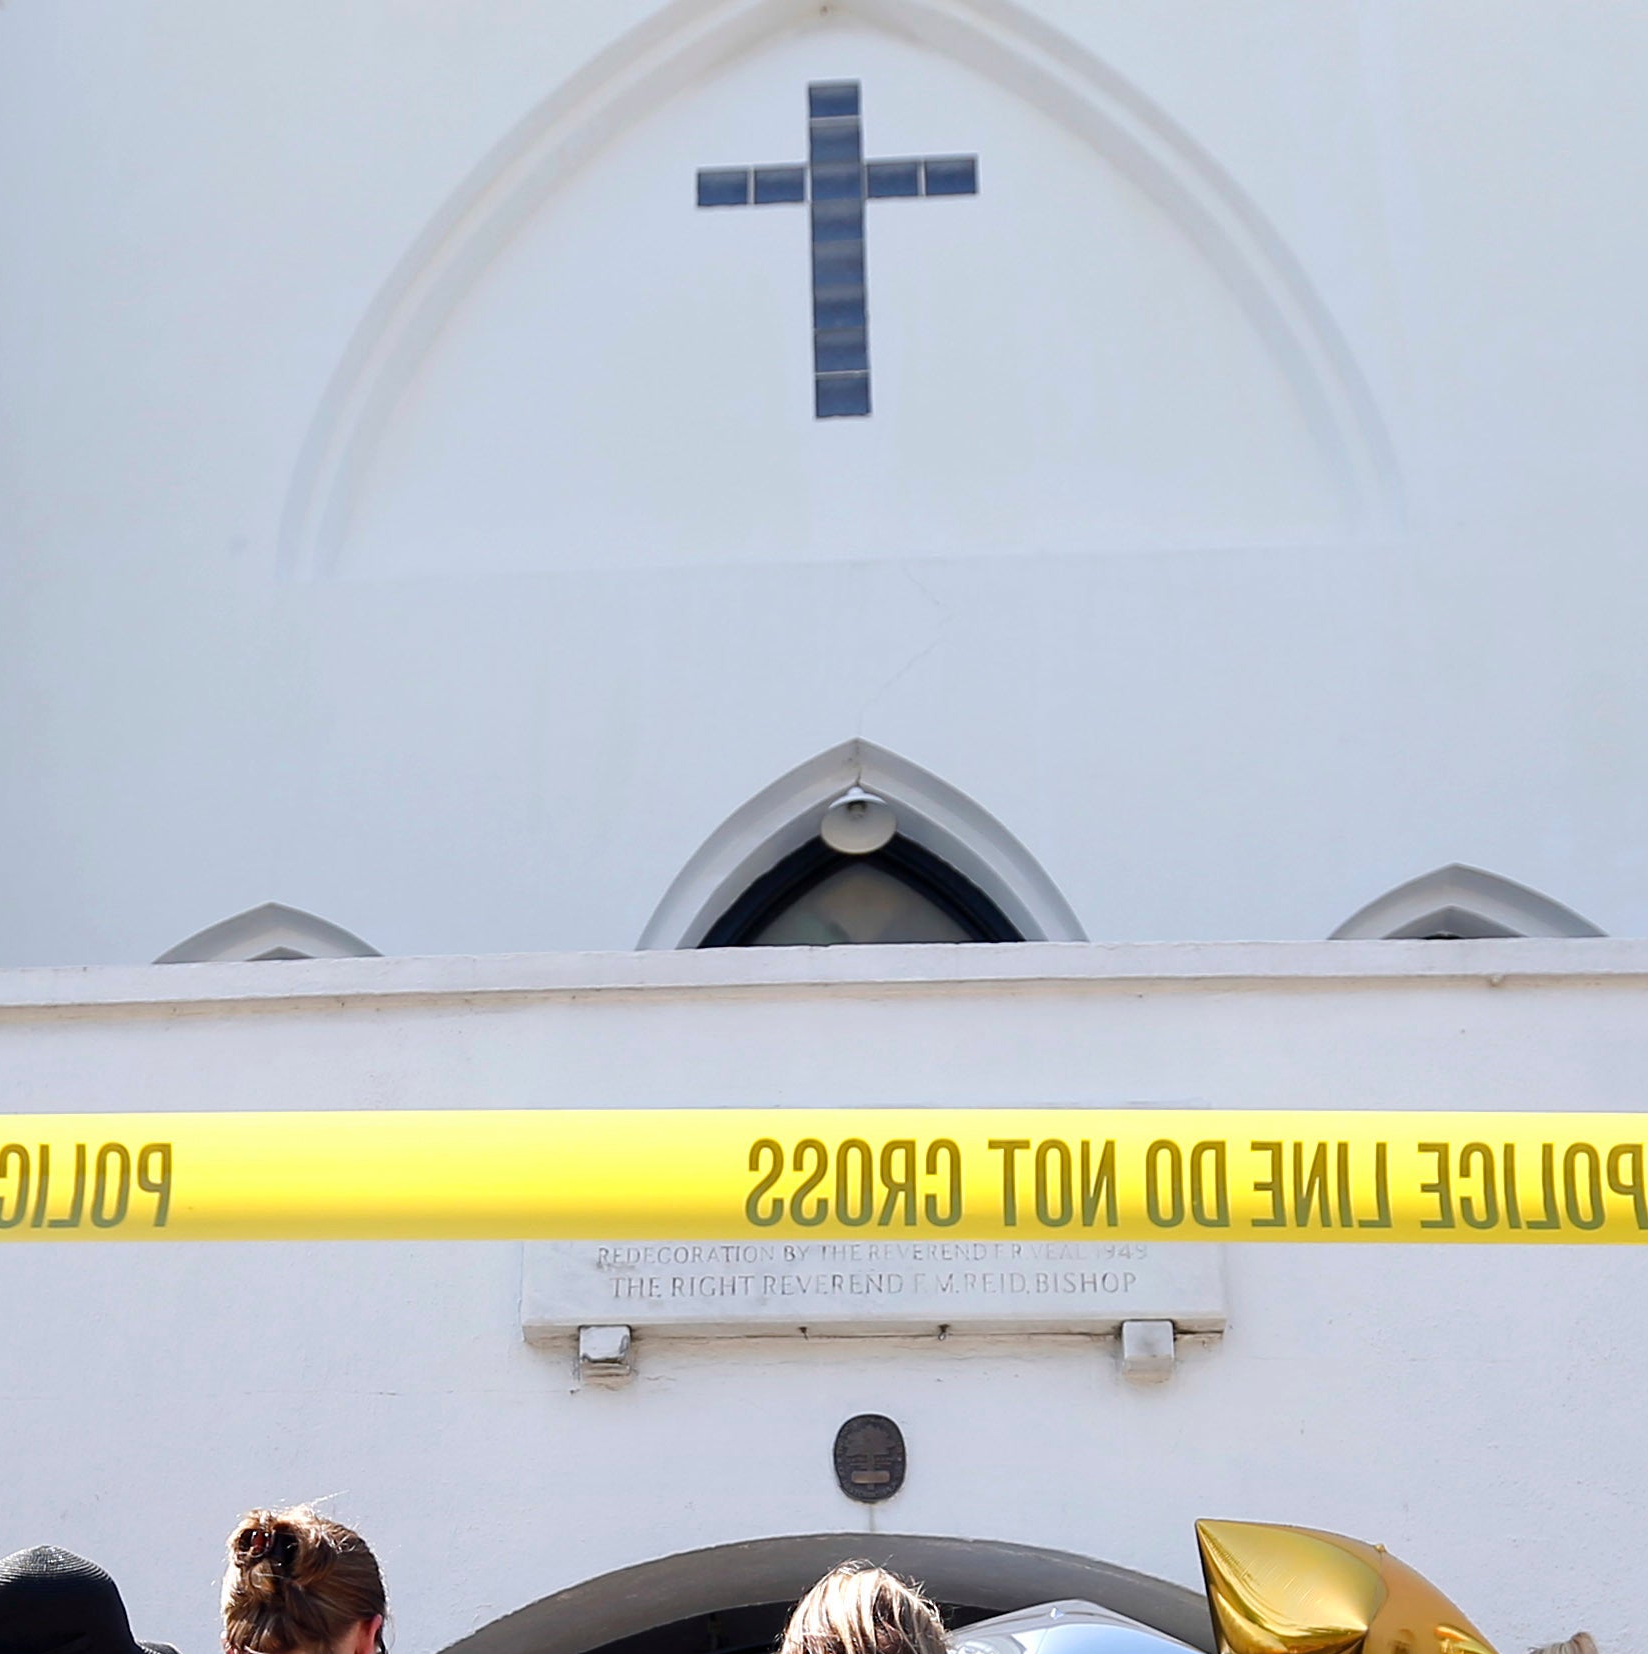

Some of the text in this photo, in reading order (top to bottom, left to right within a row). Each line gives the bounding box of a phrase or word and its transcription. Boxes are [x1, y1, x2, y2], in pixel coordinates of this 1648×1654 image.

[597, 1245, 774, 1265] REDECORATION
[783, 1244, 809, 1261] BY
[818, 1243, 862, 1261] THE
[868, 1243, 987, 1261] REVEREND
[609, 1275, 662, 1299] THE
[671, 1274, 756, 1298] RIGHT
[763, 1272, 904, 1297] REVEREND
[1036, 1271, 1138, 1294] BISHOP
